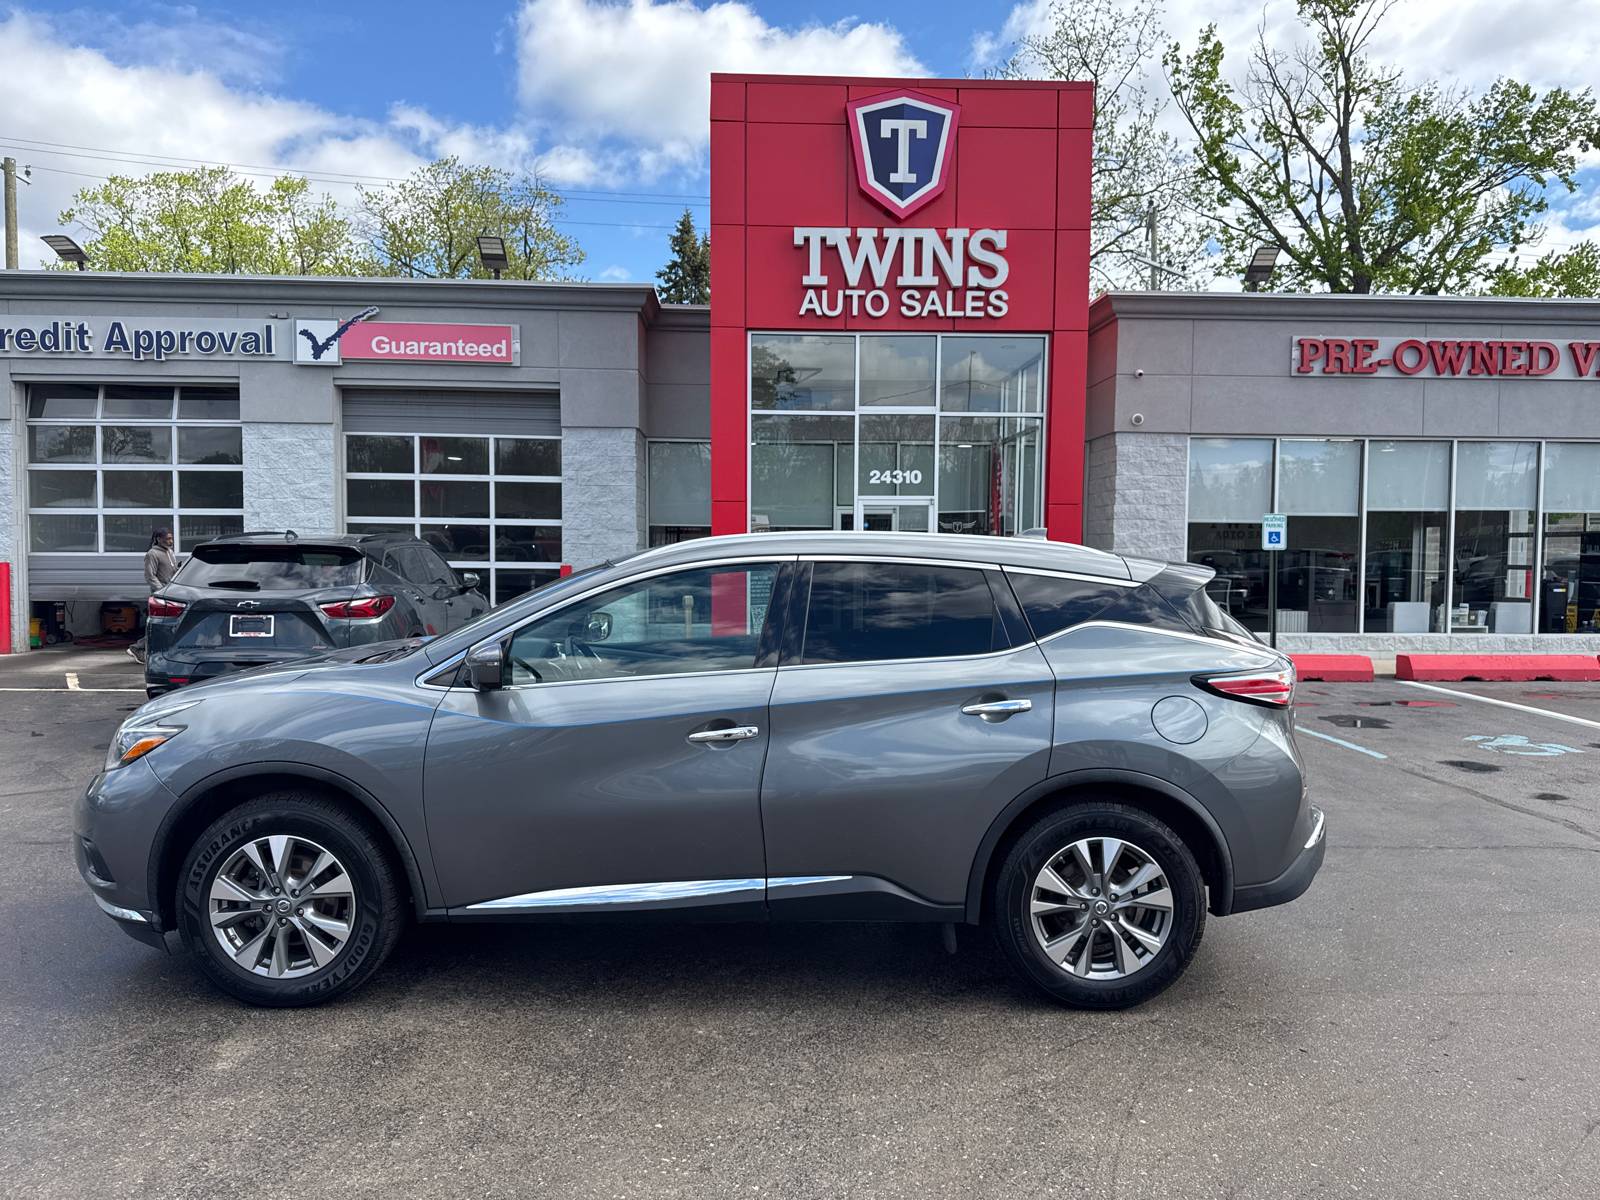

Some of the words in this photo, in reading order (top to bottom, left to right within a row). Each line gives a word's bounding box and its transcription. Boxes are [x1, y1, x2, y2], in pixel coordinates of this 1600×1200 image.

[880, 119, 927, 183] T
[793, 227, 1009, 288] TWINS
[799, 289, 890, 317] AUTO
[900, 289, 1009, 317] SALES
[103, 321, 276, 360] Approval
[371, 336, 507, 357] Guaranteed
[1297, 338, 1560, 376] PRE-OWNED
[1568, 342, 1600, 377] V
[869, 469, 922, 484] 24310
